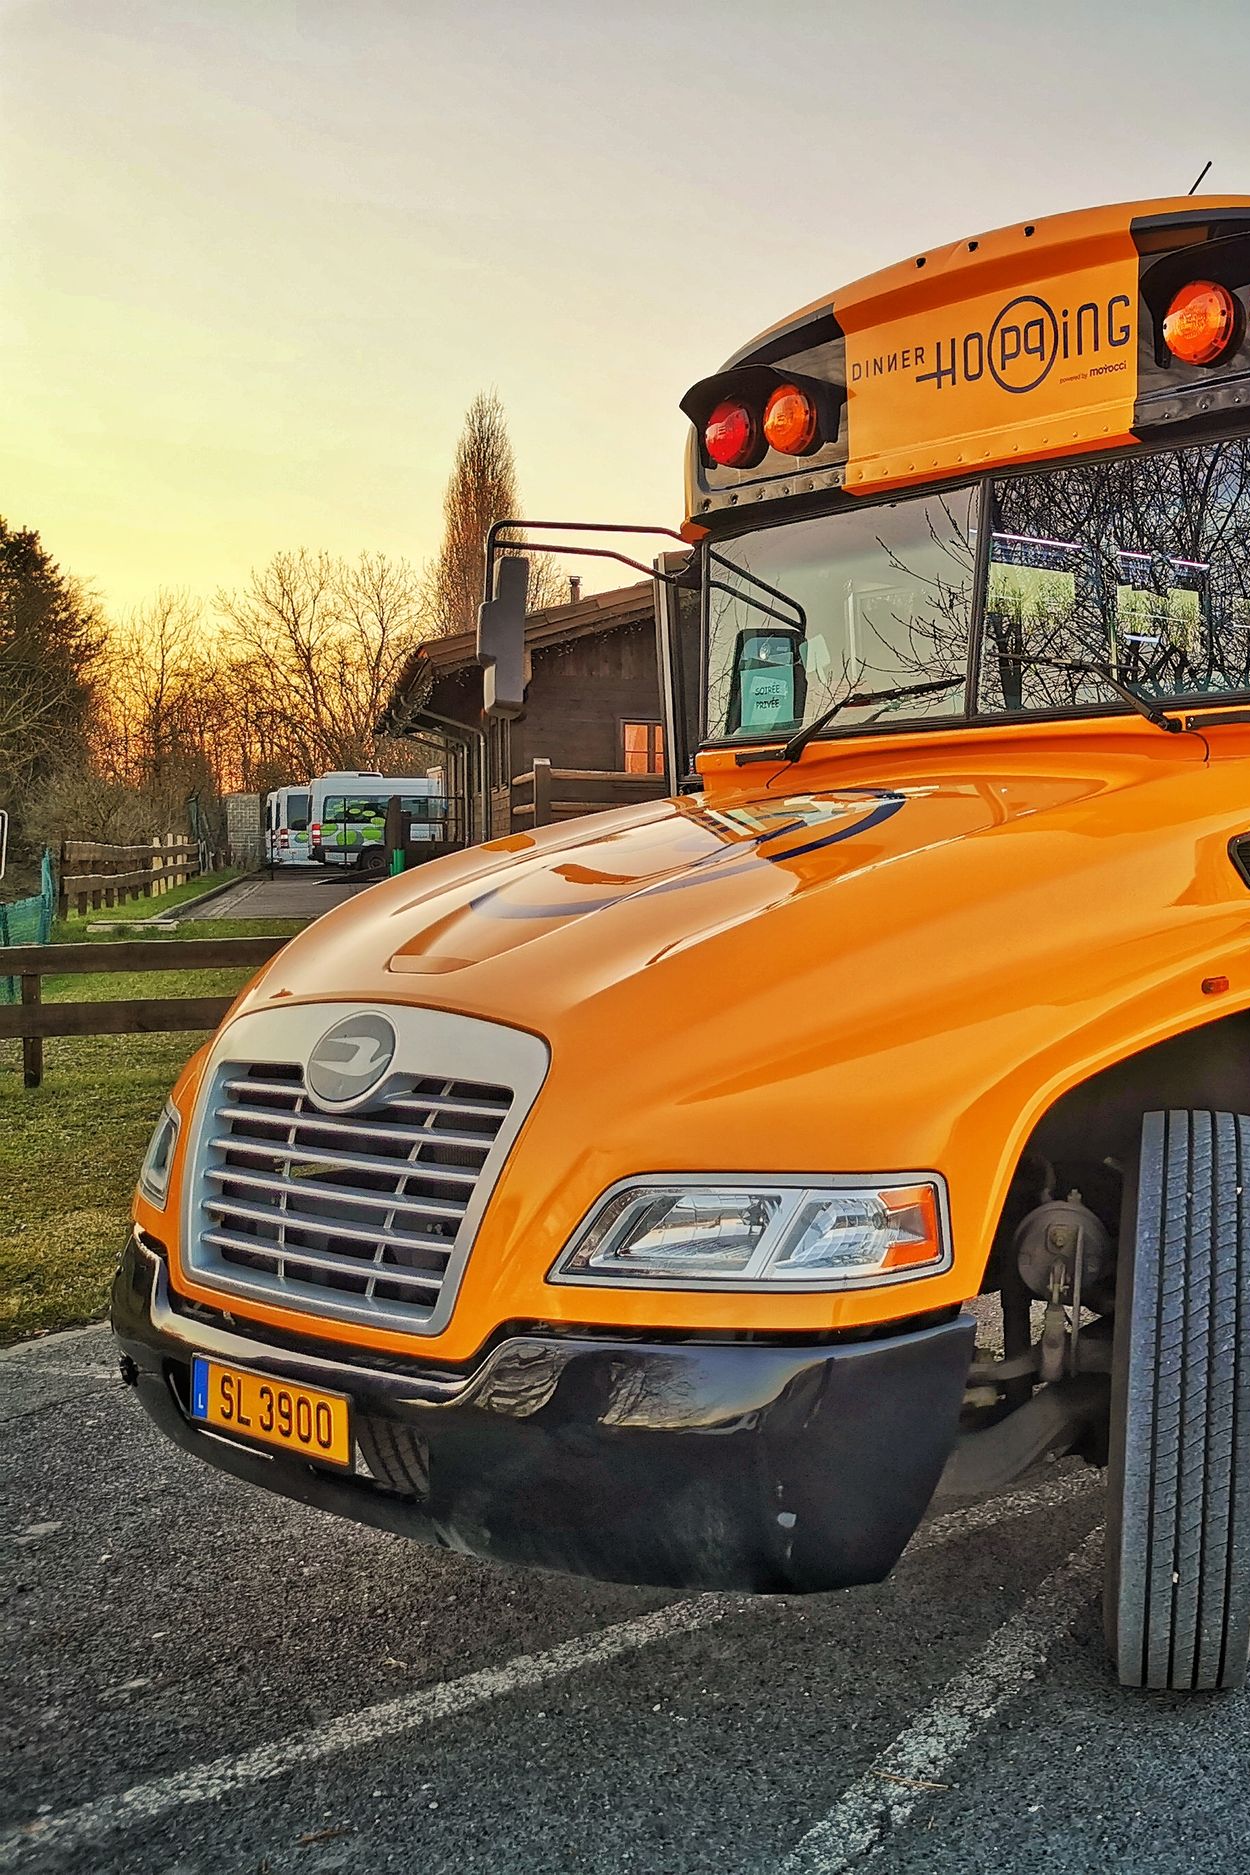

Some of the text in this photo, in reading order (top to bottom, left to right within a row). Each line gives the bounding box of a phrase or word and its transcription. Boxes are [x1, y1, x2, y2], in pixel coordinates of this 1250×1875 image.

[852, 346, 925, 382] DINNER
[755, 682, 780, 695] SOIRÉE
[755, 697, 780, 709] PRIVÉE
[220, 1372, 252, 1427] SL
[259, 1383, 334, 1450] 3900
